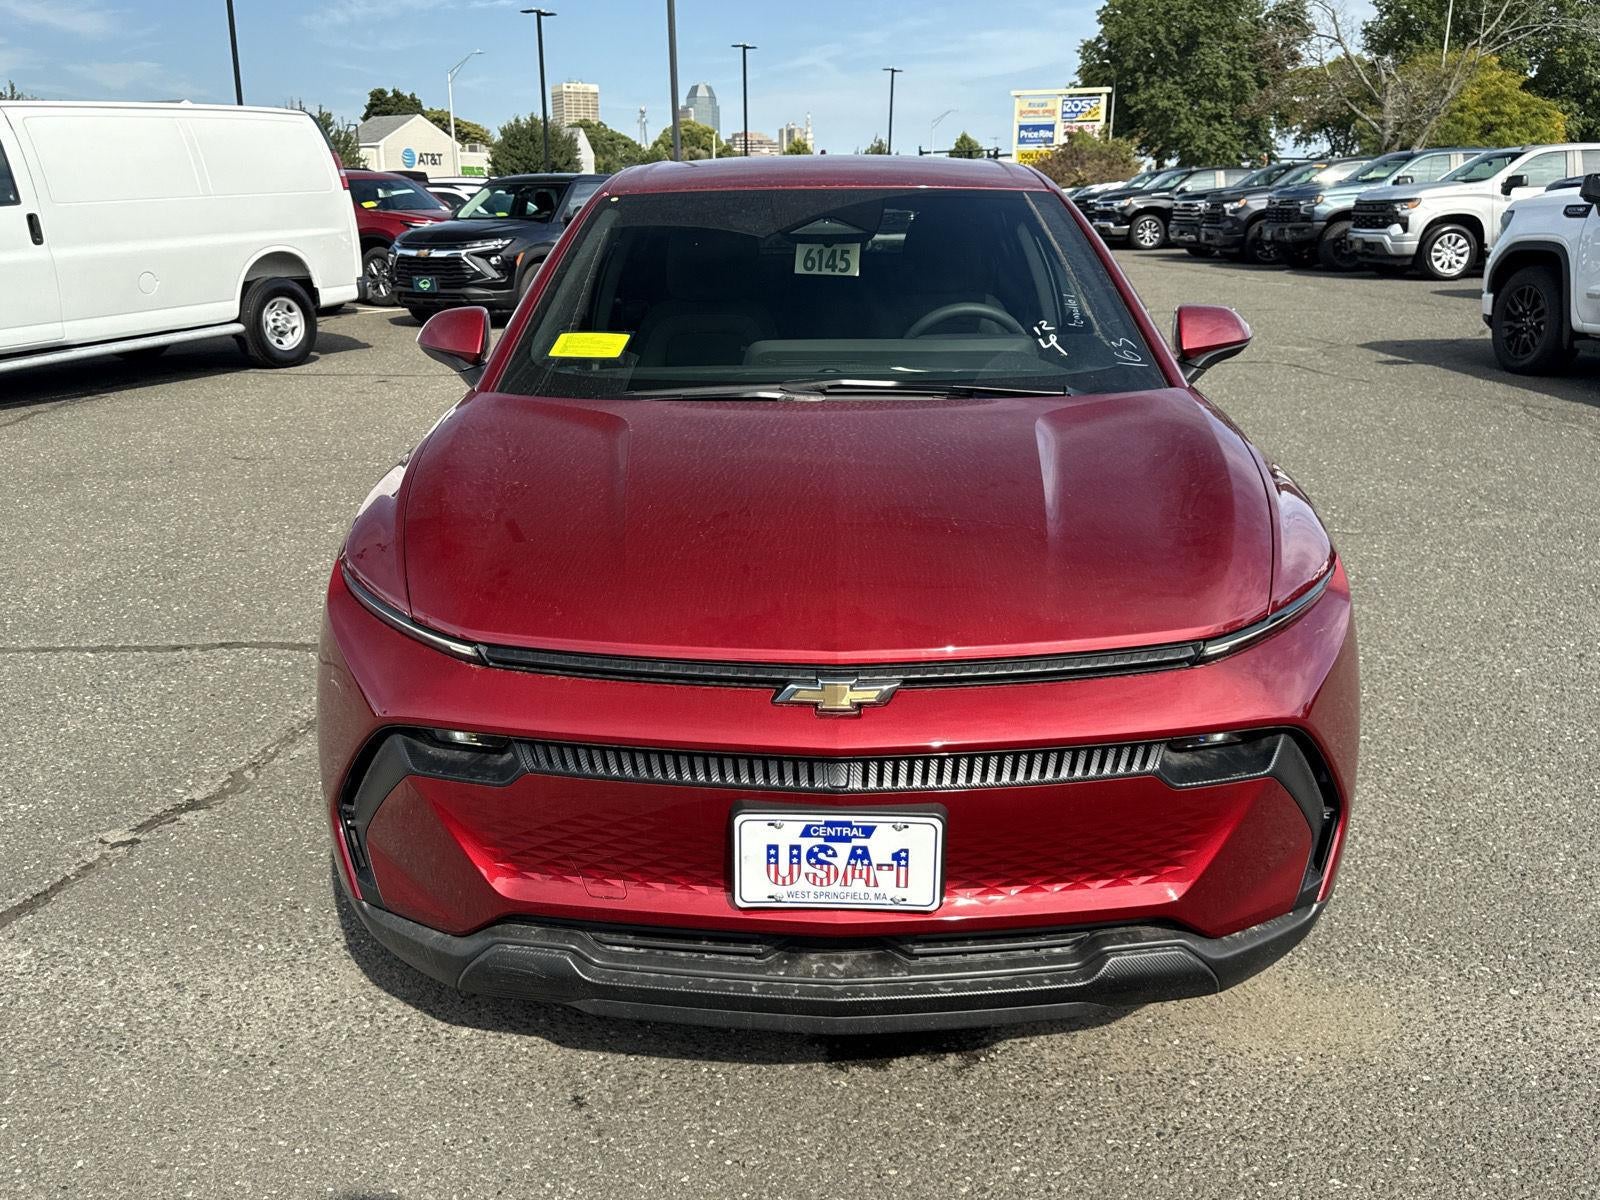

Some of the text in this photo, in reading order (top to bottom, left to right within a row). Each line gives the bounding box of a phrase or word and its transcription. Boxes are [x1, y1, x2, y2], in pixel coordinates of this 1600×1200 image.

[418, 153, 443, 165] AT&T
[803, 248, 851, 273] 6145
[810, 826, 865, 837] CENTRAL
[766, 843, 909, 889] USA-1
[787, 890, 887, 901] WEST SPRINGFIELD, MA
